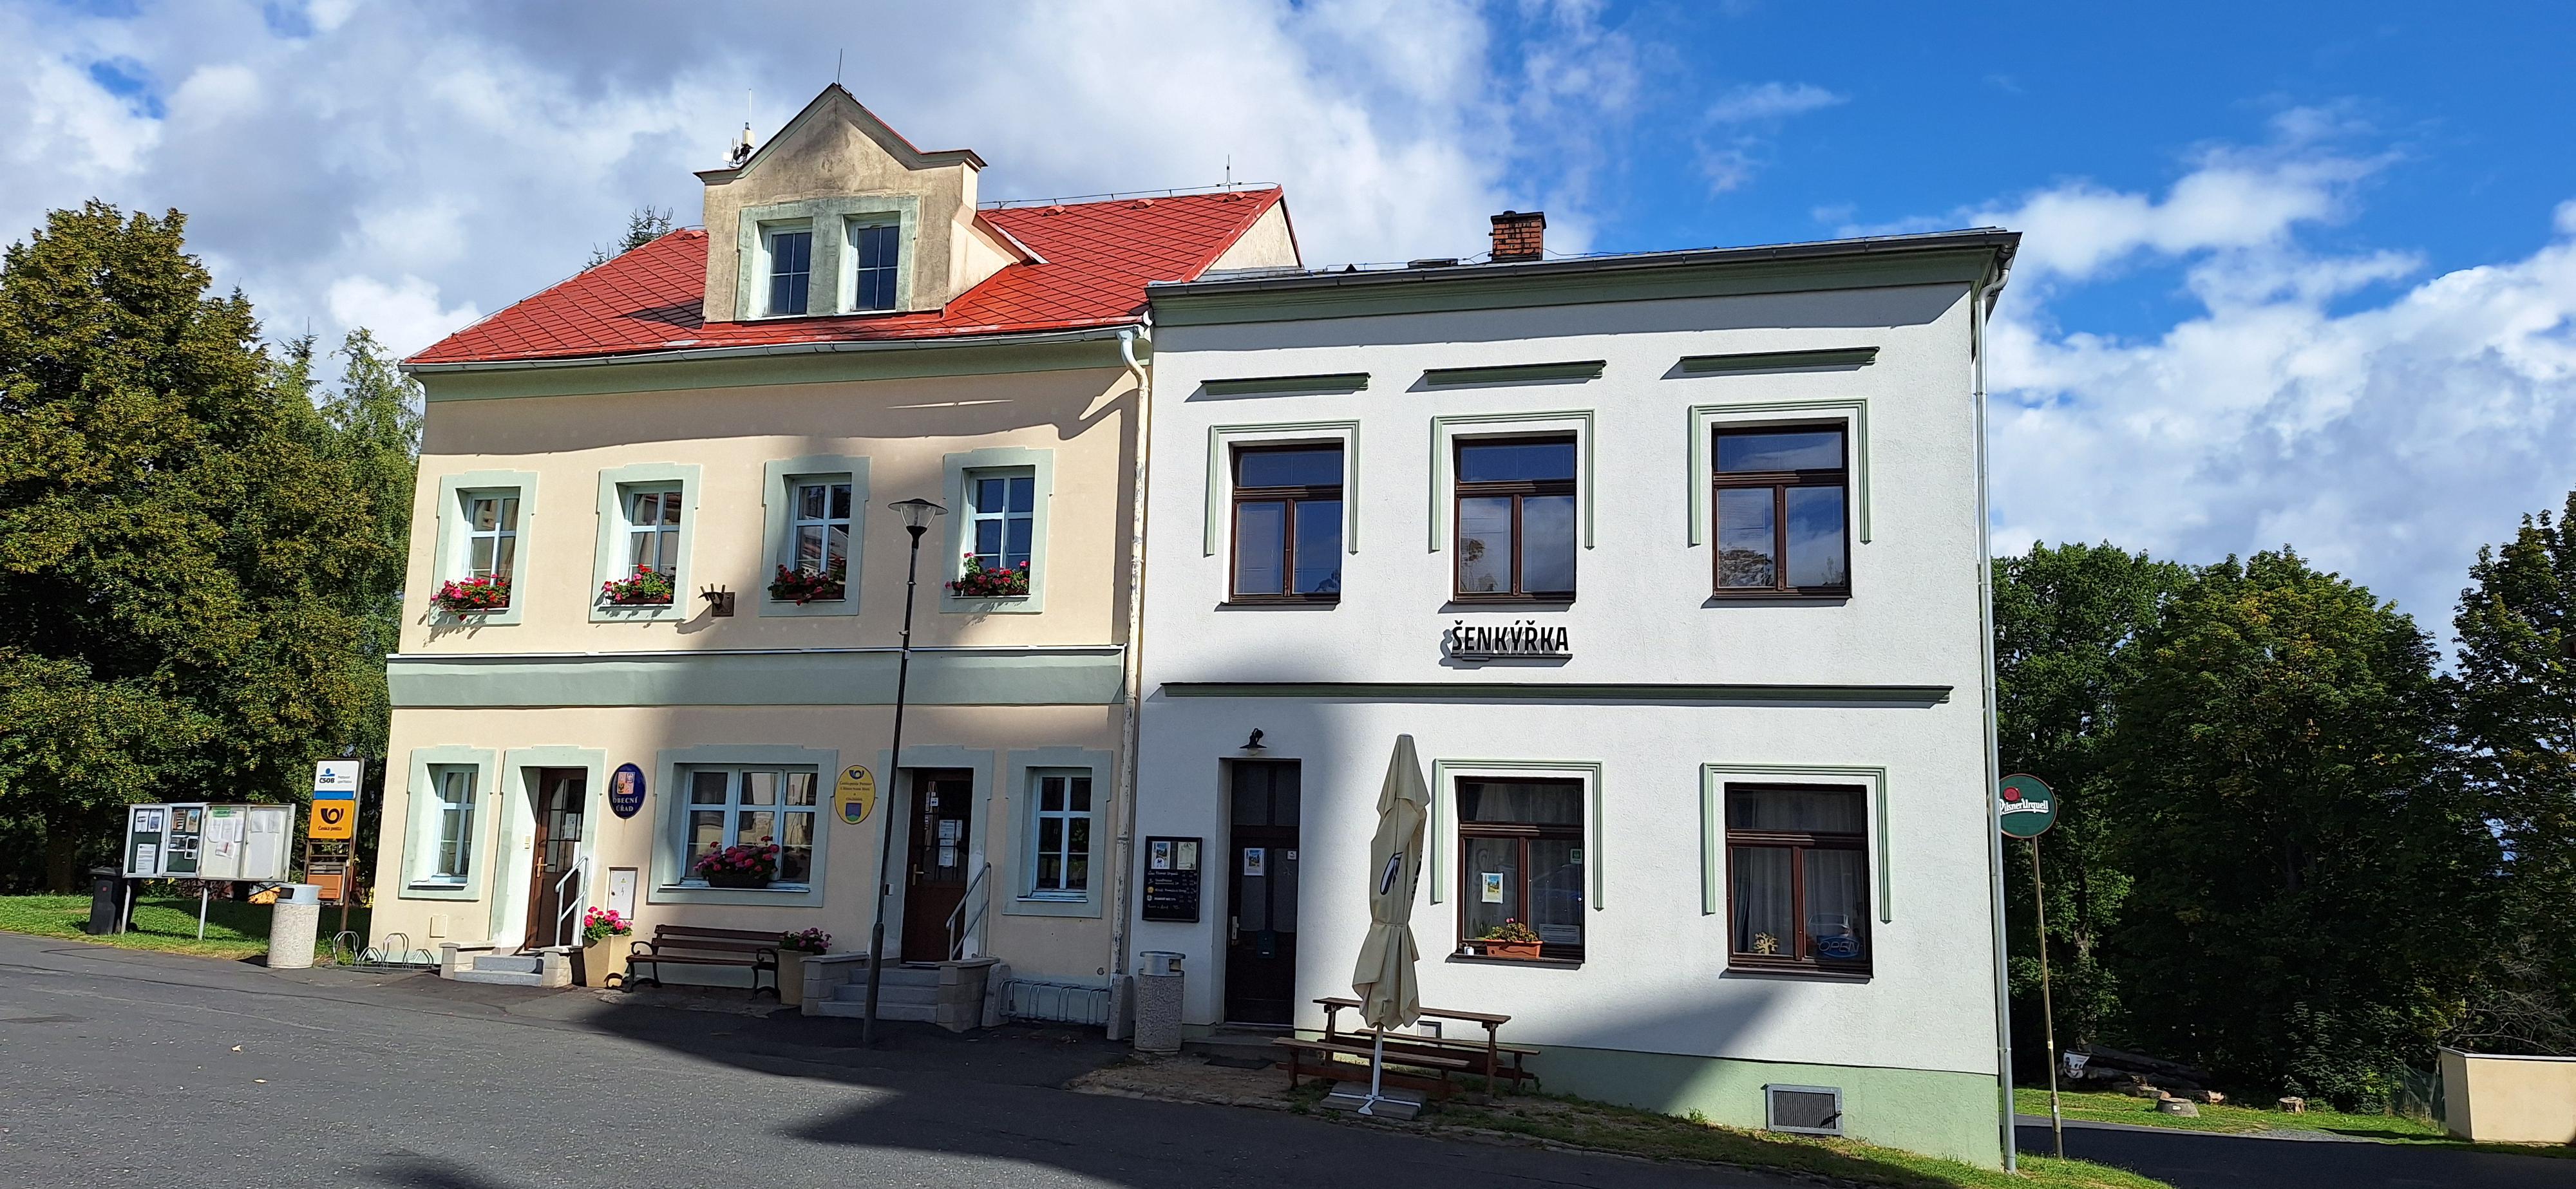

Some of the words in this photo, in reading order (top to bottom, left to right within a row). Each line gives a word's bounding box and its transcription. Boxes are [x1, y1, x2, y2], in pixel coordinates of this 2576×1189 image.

[1452, 619, 1569, 651] ŠENKÝŘKA
[1999, 798, 2023, 816] Pilsner
[2022, 798, 2049, 814] Urquell
[1819, 941, 1860, 953] OPEN
